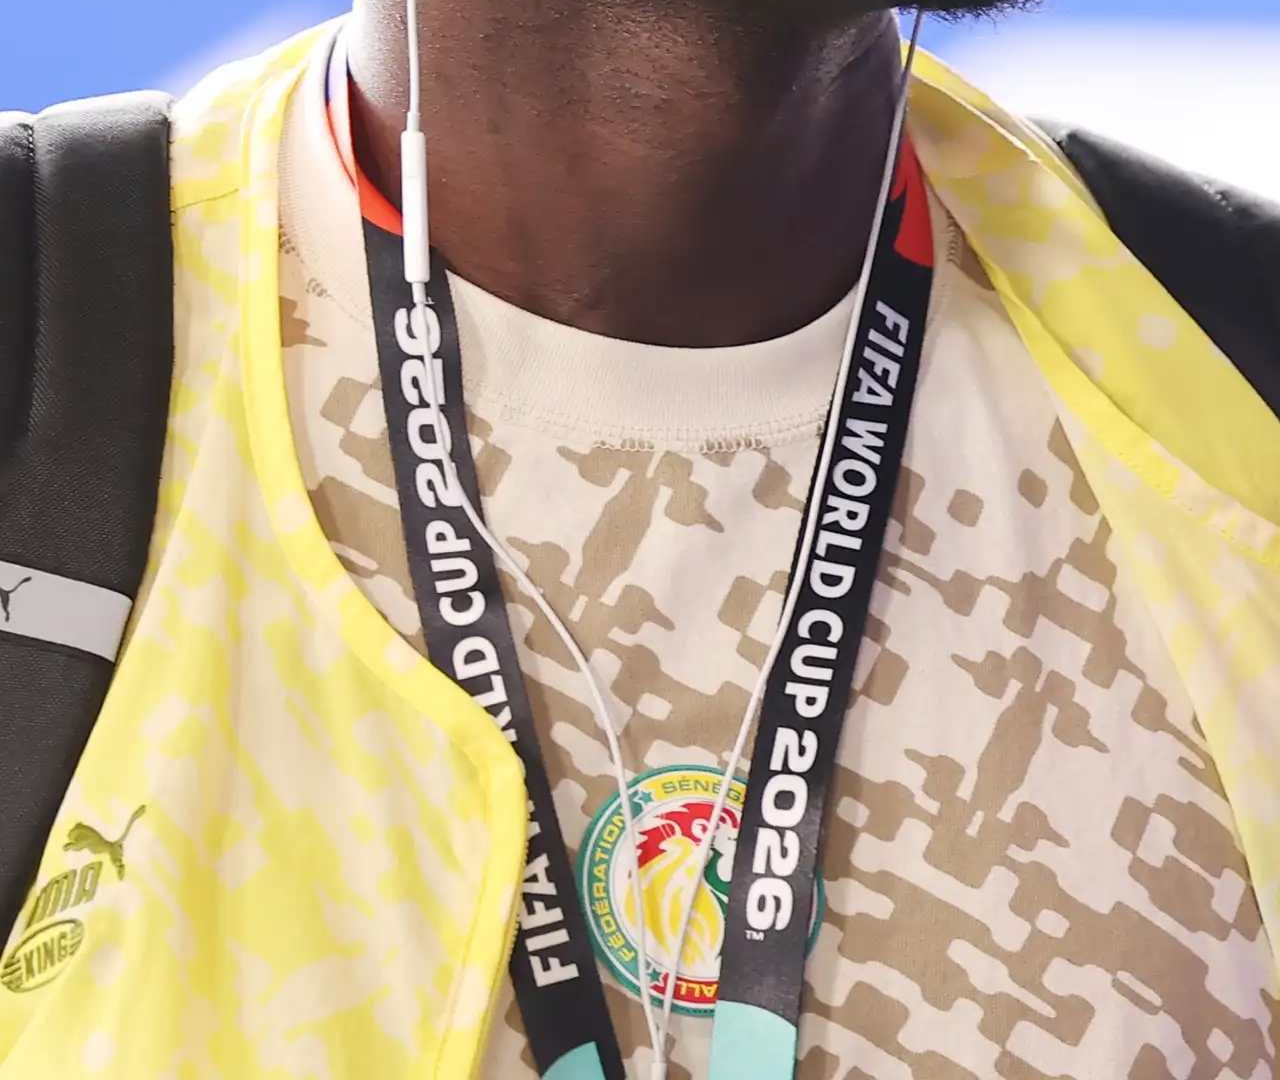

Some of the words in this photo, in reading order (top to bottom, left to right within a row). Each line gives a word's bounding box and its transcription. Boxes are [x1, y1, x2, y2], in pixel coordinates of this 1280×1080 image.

[394, 306, 464, 508] 2026
[851, 299, 910, 407] FIFA
[809, 418, 889, 599] WORLD
[425, 520, 486, 626] CUP
[784, 609, 845, 719] CUP
[661, 775, 744, 805] SÉNÉG
[745, 726, 819, 931] 2026
[26, 860, 103, 928] MA
[520, 853, 580, 988] FIFA
[22, 931, 69, 982] KING
